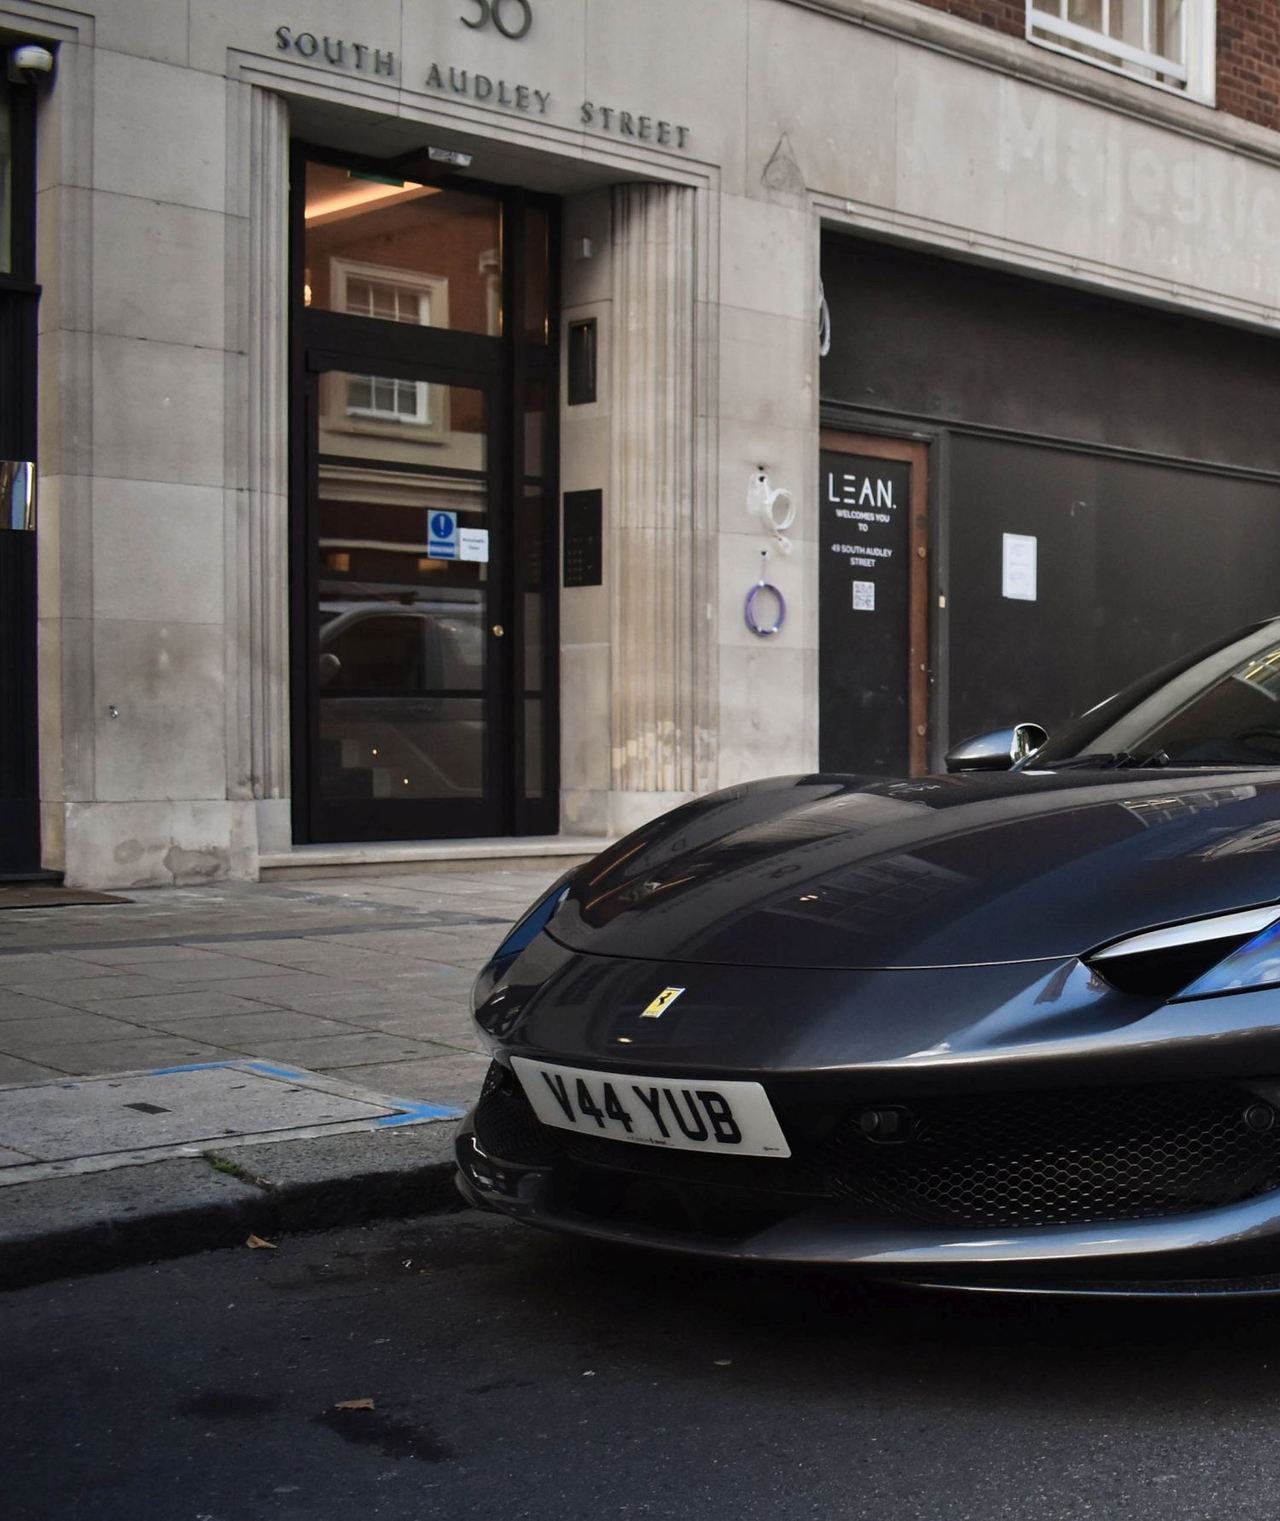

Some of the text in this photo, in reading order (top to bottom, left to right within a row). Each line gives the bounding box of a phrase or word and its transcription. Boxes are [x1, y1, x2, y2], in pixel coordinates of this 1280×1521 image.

[275, 26, 690, 148] SOUTH AUDLEY STREET
[835, 508, 890, 523] WELCOMES YOU
[858, 523, 868, 532] TO
[841, 544, 865, 555] SOUTH
[866, 547, 892, 557] AUDLEY
[850, 557, 876, 568] STREET
[540, 1071, 742, 1144] V44 YUB
